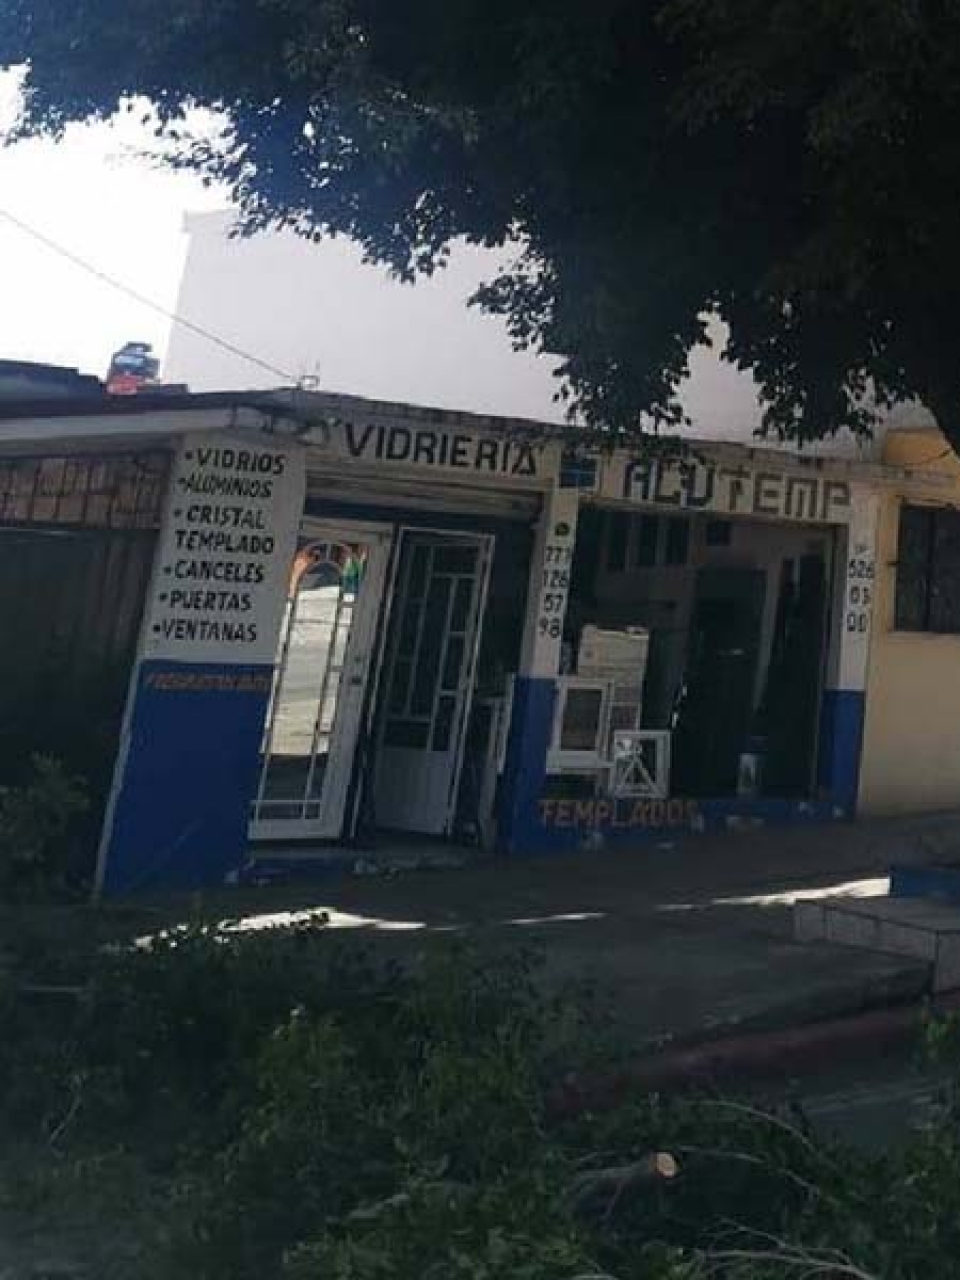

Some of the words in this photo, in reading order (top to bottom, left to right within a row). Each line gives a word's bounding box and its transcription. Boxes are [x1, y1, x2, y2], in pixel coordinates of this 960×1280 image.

[197, 449, 285, 475] VIDRIOS
[186, 505, 265, 530] CRISTAL
[175, 530, 274, 554] TEMPLADO
[174, 561, 265, 583] CANCELES
[170, 590, 252, 611] PUERTAS
[543, 593, 564, 613] 57
[162, 619, 257, 642] VENTANAS
